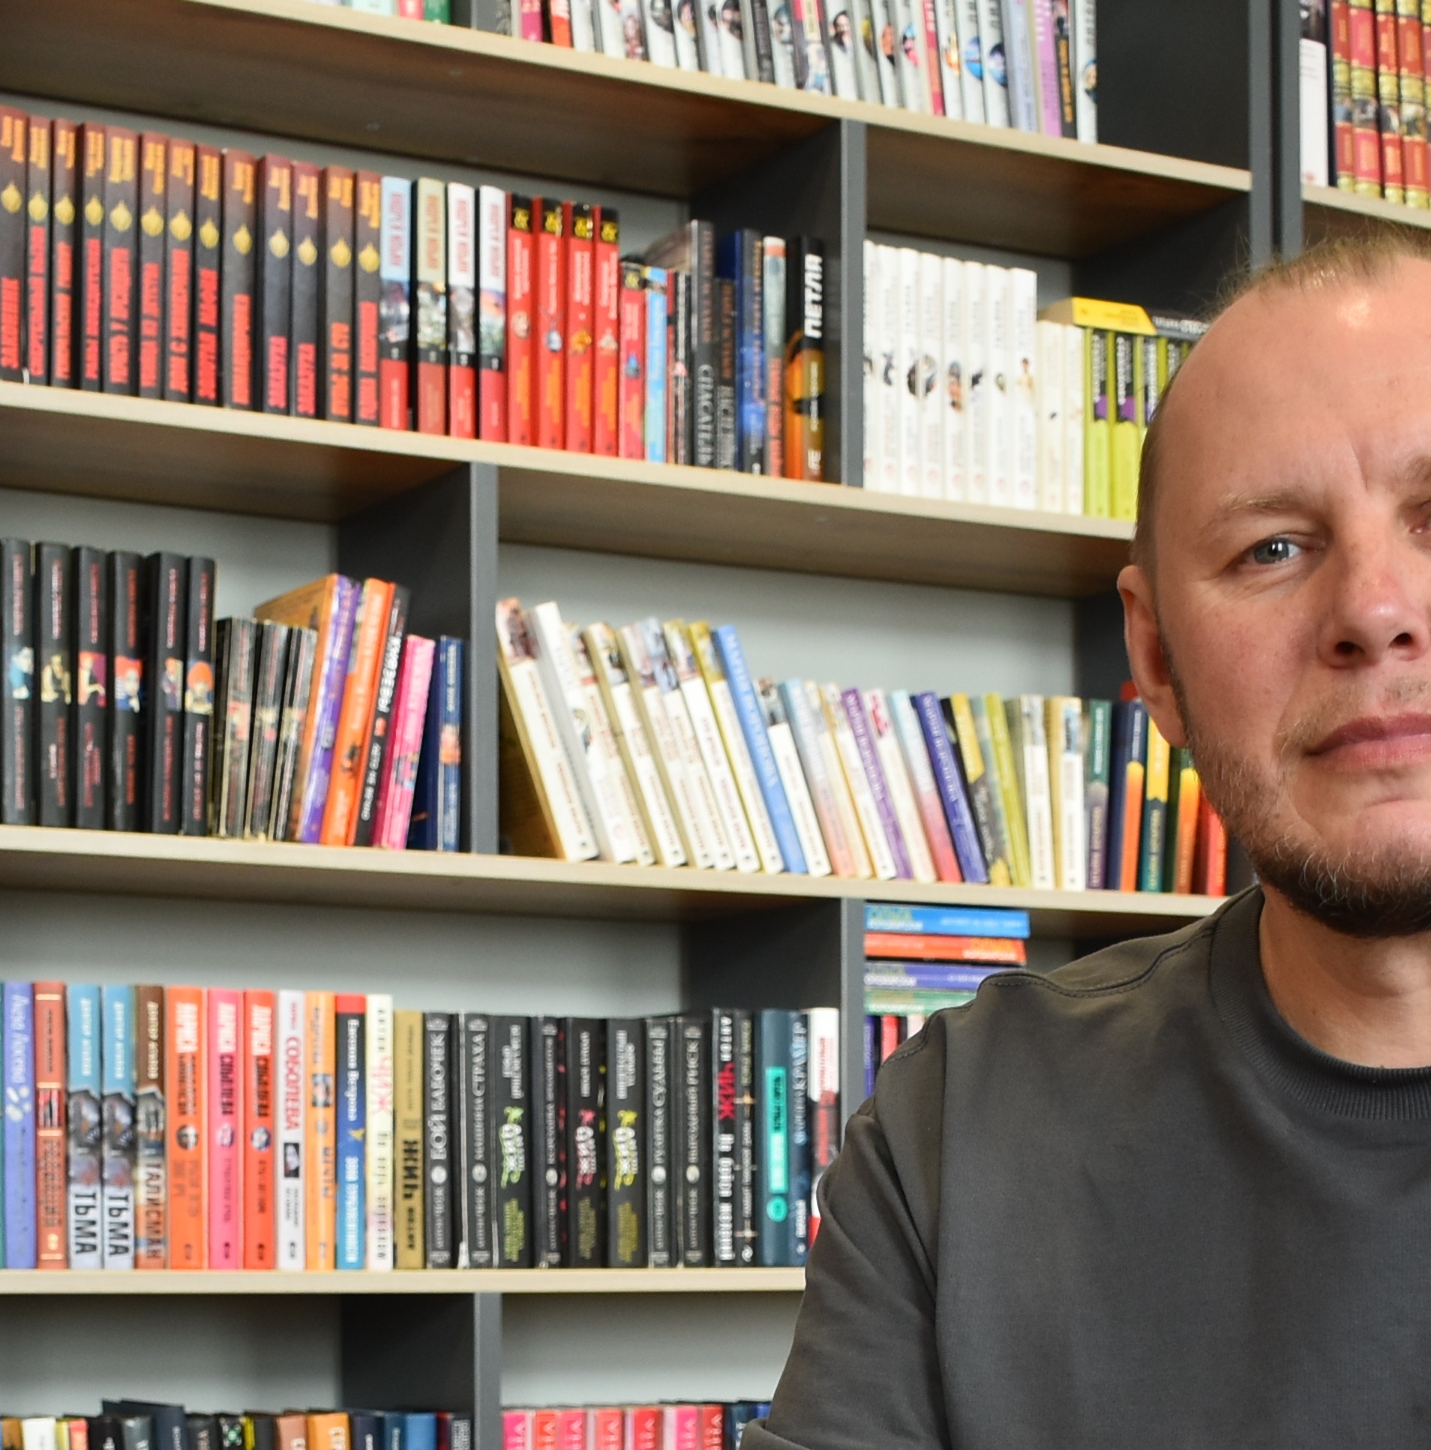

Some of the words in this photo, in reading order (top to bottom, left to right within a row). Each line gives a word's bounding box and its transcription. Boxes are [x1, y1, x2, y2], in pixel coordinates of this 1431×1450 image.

[806, 254, 822, 338] ПЕТЛЯ
[699, 365, 713, 466] СПАСАТЕЛЬ
[285, 1037, 301, 1130] СОБОЛЕВА
[429, 1033, 446, 1110] БАБОЧЕК
[473, 1034, 487, 1096] СТРАХА
[717, 1063, 736, 1121] ЧИЖ
[429, 1114, 447, 1160] БОЙ
[75, 1192, 97, 1255] ТЬМА
[109, 1195, 130, 1256] ТЬМА
[146, 1162, 163, 1260] ТАЛИСМАН
